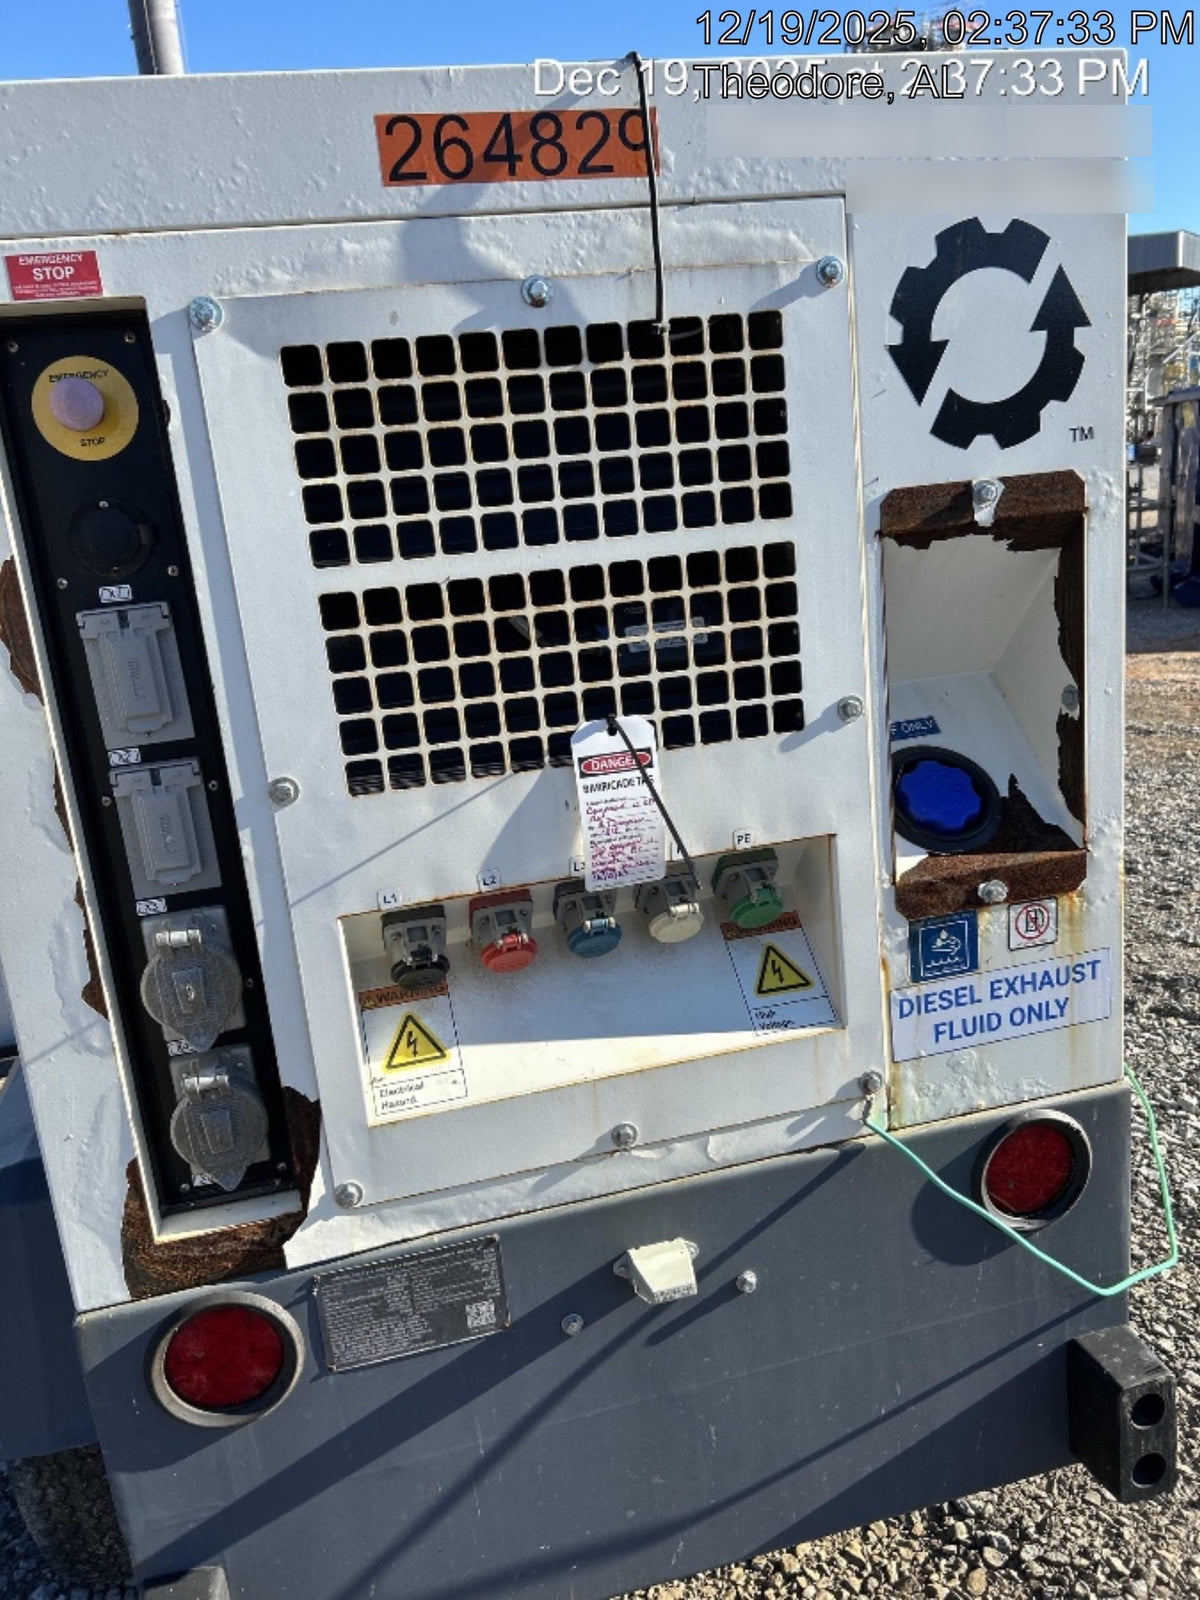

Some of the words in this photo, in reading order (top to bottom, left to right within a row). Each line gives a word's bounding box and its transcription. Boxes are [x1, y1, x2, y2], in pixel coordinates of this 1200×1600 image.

[19, 254, 83, 266] EMERGENCY
[33, 266, 74, 281] STOP
[1069, 426, 1095, 442] TM
[81, 437, 105, 447] STOP
[591, 755, 640, 771] DANGE
[737, 833, 751, 845] PE
[482, 874, 497, 886] L2
[899, 984, 982, 1019] DIESEL
[989, 960, 1102, 1001] EXHAUST
[934, 1012, 1002, 1044] FLUID
[1009, 997, 1069, 1027] ONLY
